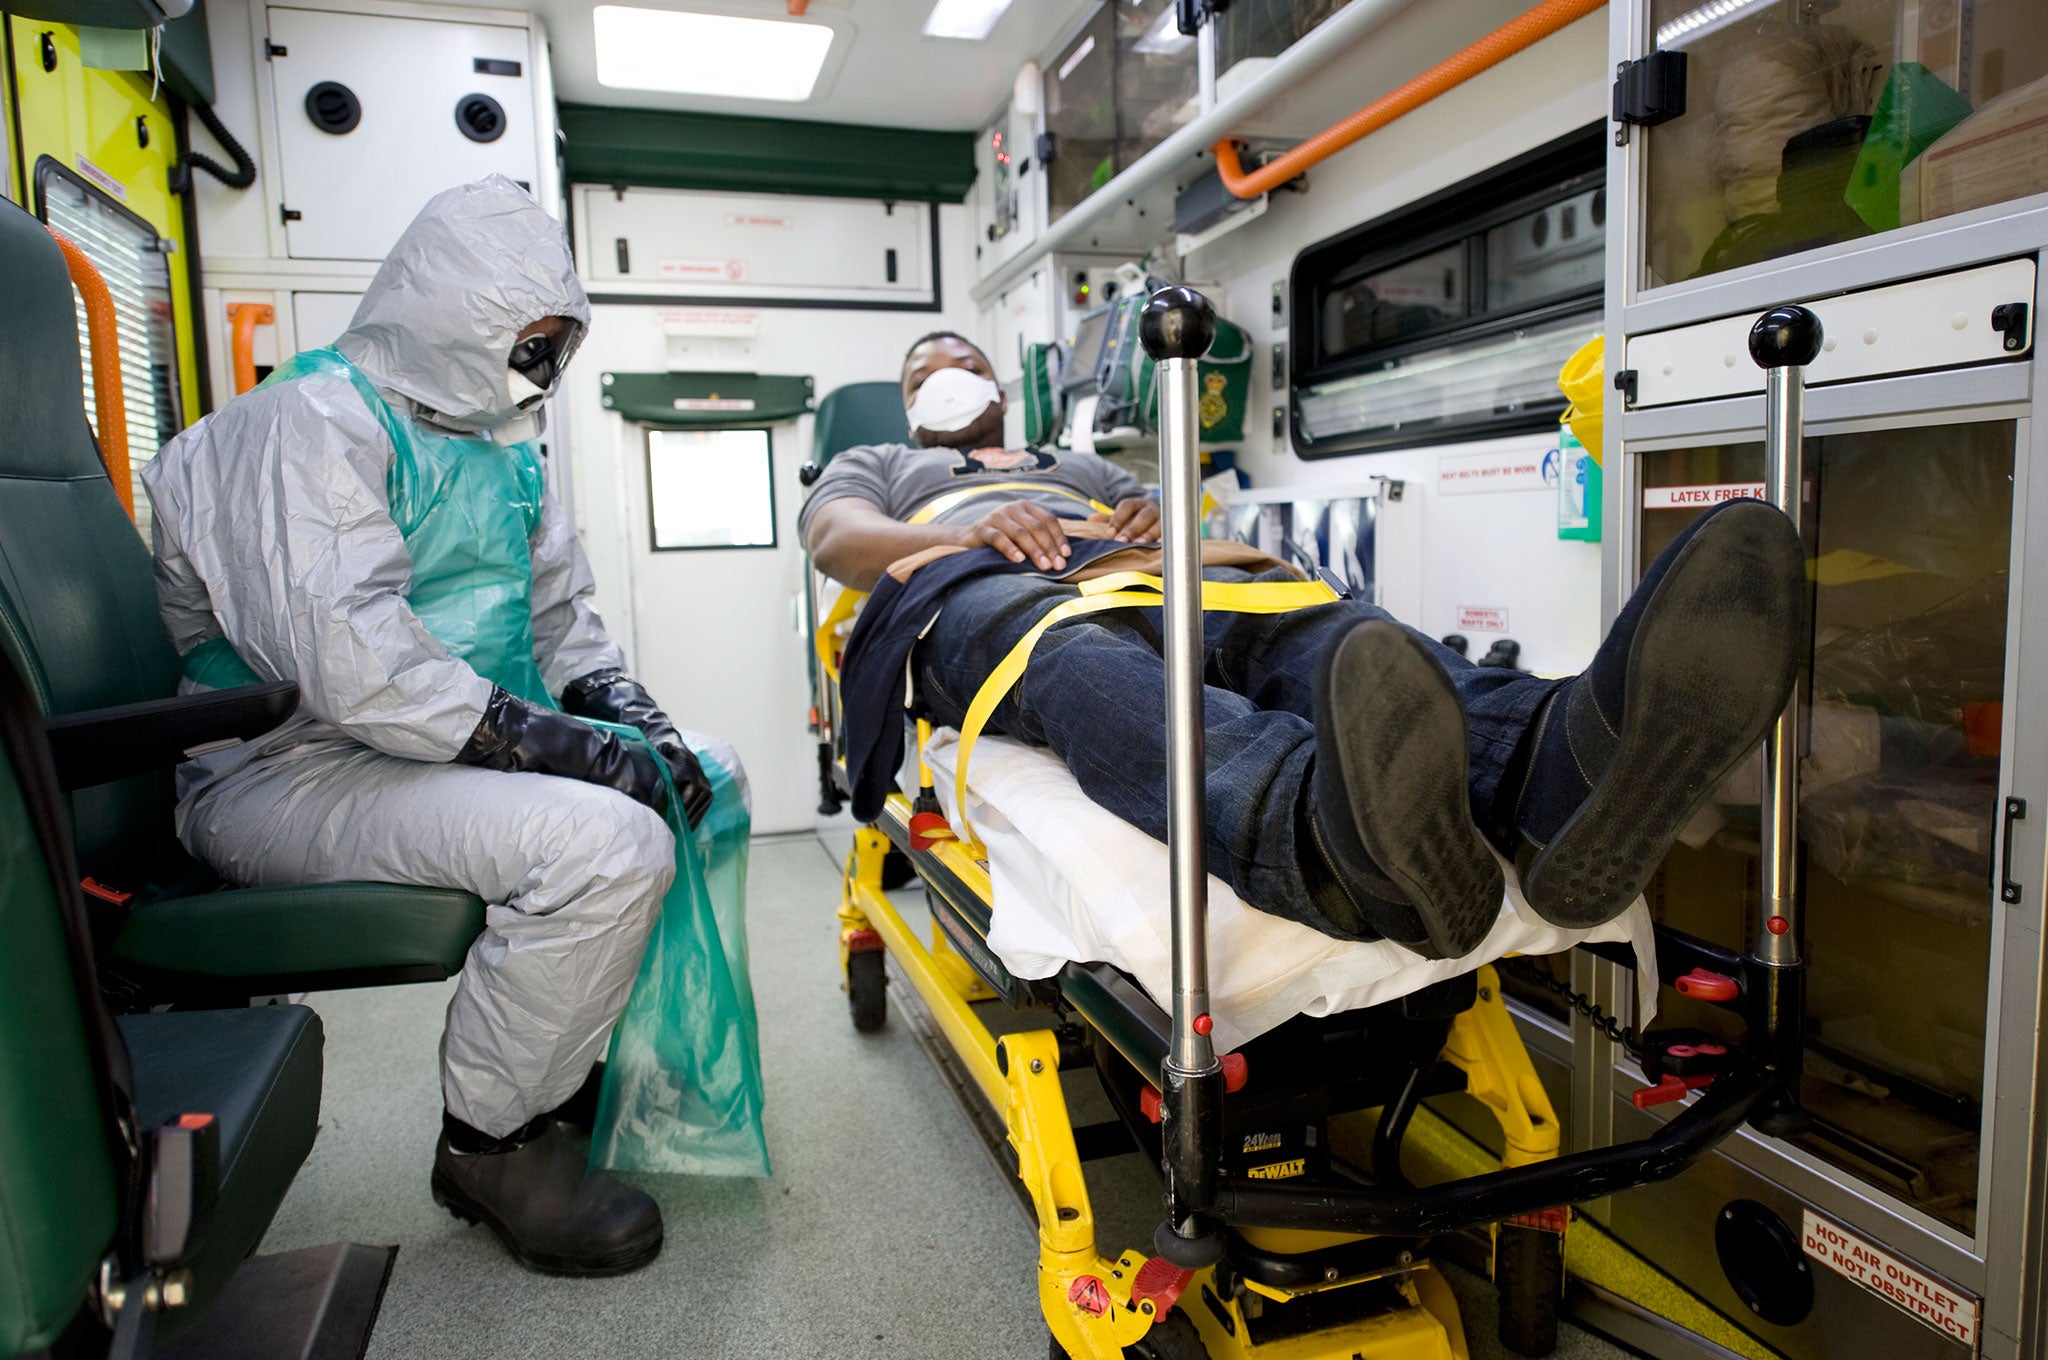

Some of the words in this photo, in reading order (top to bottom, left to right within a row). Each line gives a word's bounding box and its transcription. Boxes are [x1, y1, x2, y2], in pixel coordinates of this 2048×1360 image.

[1482, 468, 1500, 476] MUST
[1503, 466, 1512, 475] BE
[1514, 465, 1537, 474] WORN
[1671, 490, 1711, 503] LATEX
[1715, 488, 1749, 501] FREE
[1806, 1235, 1828, 1256] DO
[1832, 1250, 1867, 1279] NOT
[1870, 1274, 1969, 1339] OBSTRUCT
[1815, 1223, 1849, 1250] HOT
[1852, 1245, 1881, 1271] AIR
[1885, 1264, 1959, 1313] OUTLET
